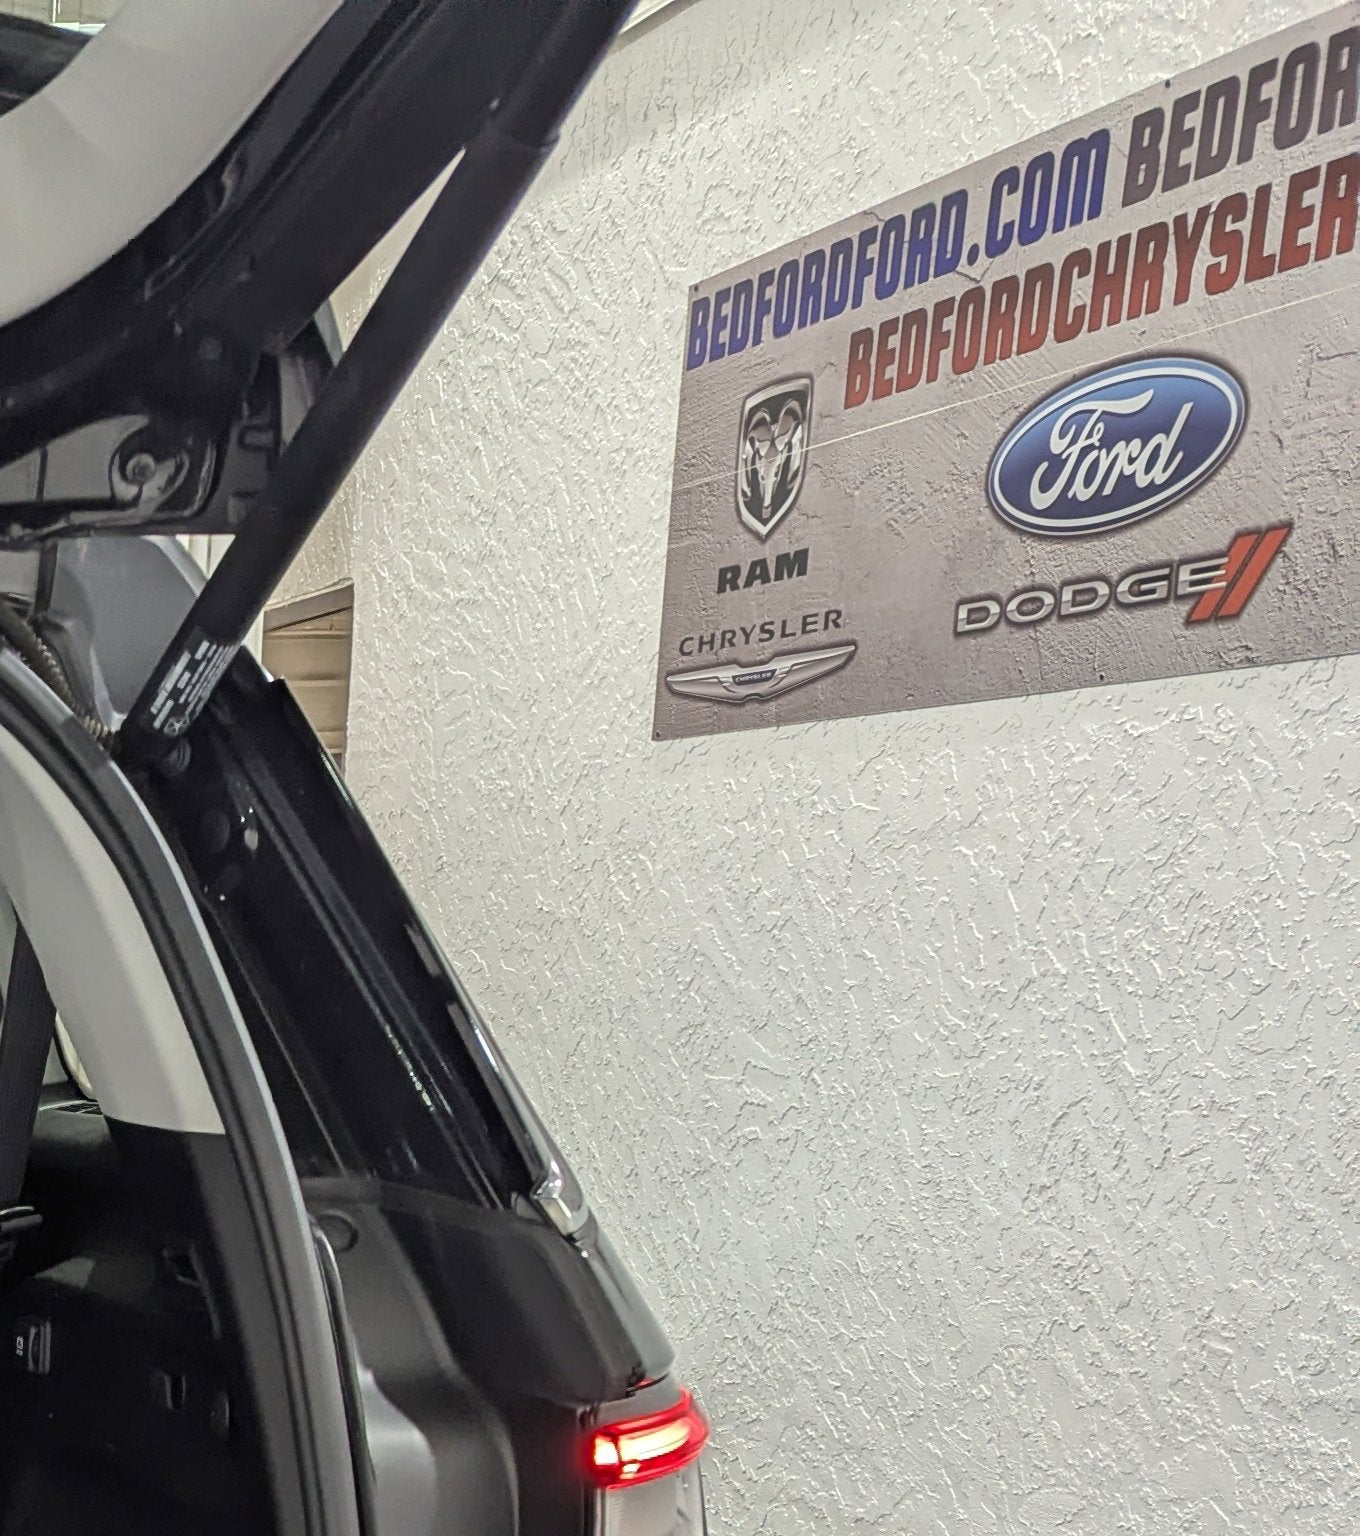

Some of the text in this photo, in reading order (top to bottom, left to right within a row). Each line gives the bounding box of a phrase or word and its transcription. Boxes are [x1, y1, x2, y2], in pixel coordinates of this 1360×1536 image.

[685, 128, 1111, 371] BEDFORDFORD.COM
[844, 152, 1360, 411] BEDFORDCHRYSLER
[1030, 388, 1194, 510] Ford
[716, 547, 810, 594] RAM
[954, 556, 1230, 633] DODGE
[680, 609, 843, 656] CHRYSLER
